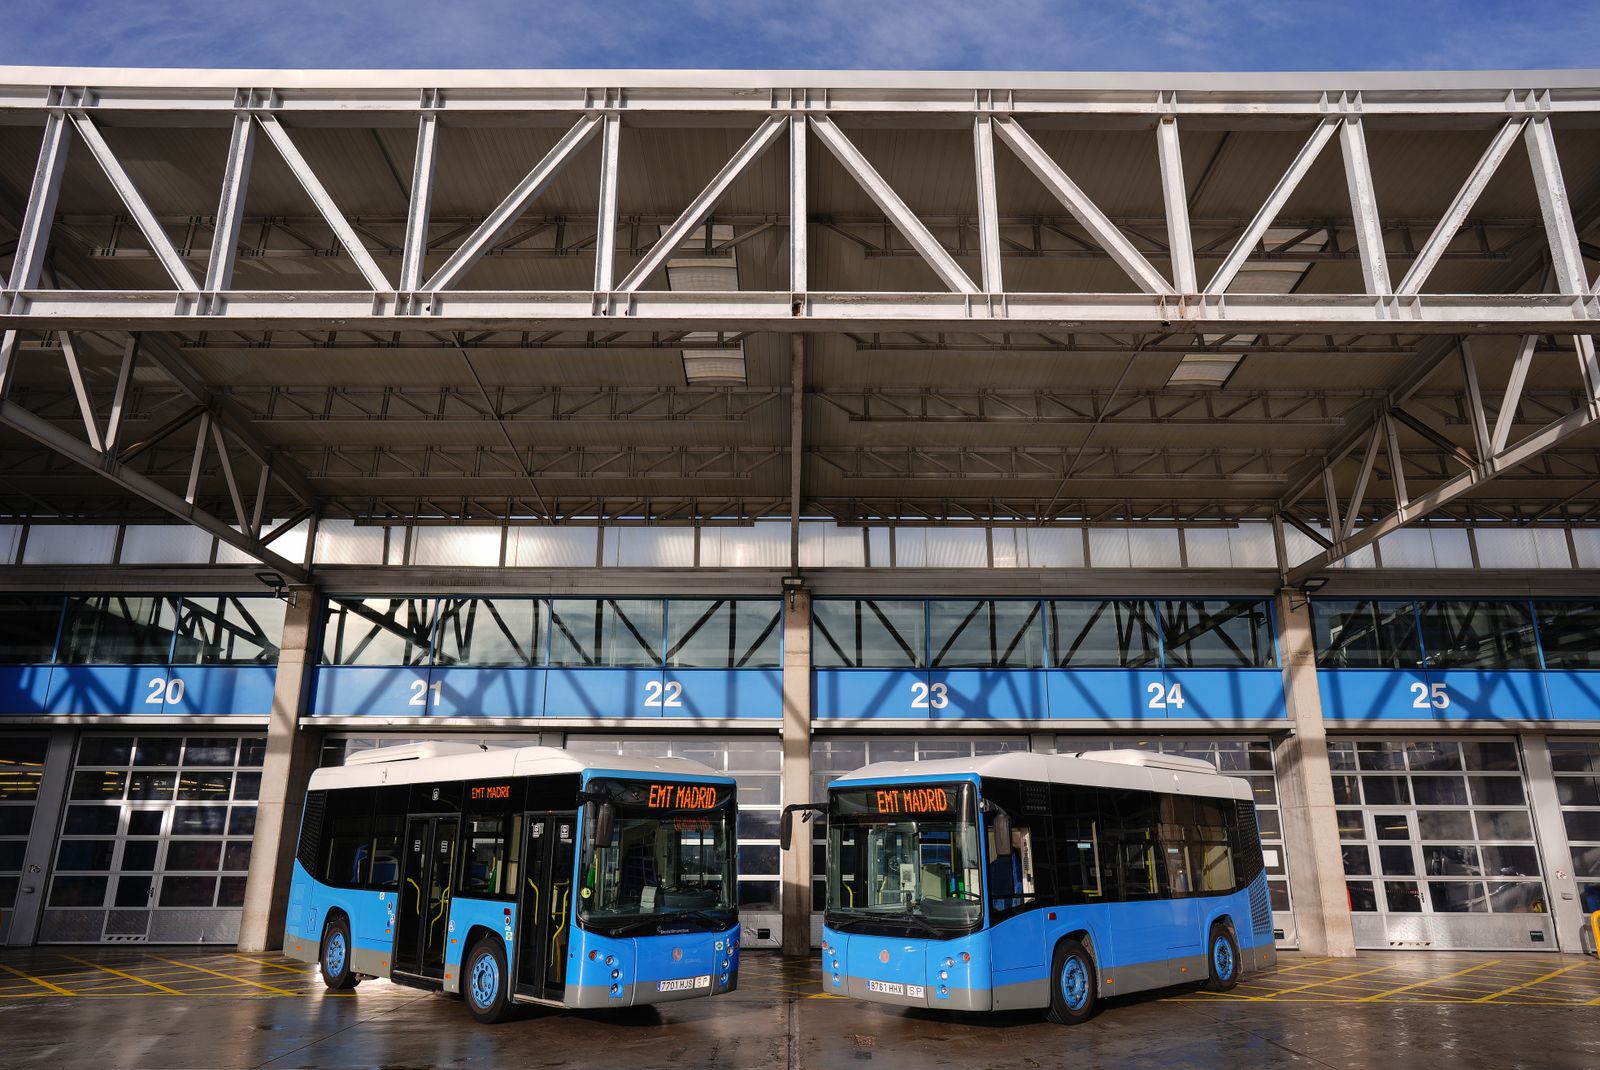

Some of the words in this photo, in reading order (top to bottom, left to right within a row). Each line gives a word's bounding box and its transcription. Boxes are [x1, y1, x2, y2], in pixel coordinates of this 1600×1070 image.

[145, 677, 186, 705] 20
[408, 679, 442, 706] 21
[642, 680, 683, 708] 22
[910, 681, 950, 709] 23
[1147, 682, 1185, 709] 24
[1410, 682, 1451, 709] 25
[471, 787, 485, 799] EMT
[648, 784, 674, 809] EMT
[675, 785, 717, 809] MADRID
[876, 790, 899, 813] EMT
[902, 788, 948, 812] MADRID
[697, 977, 709, 988] SP
[870, 981, 887, 992] 8761
[909, 986, 922, 996] SP
